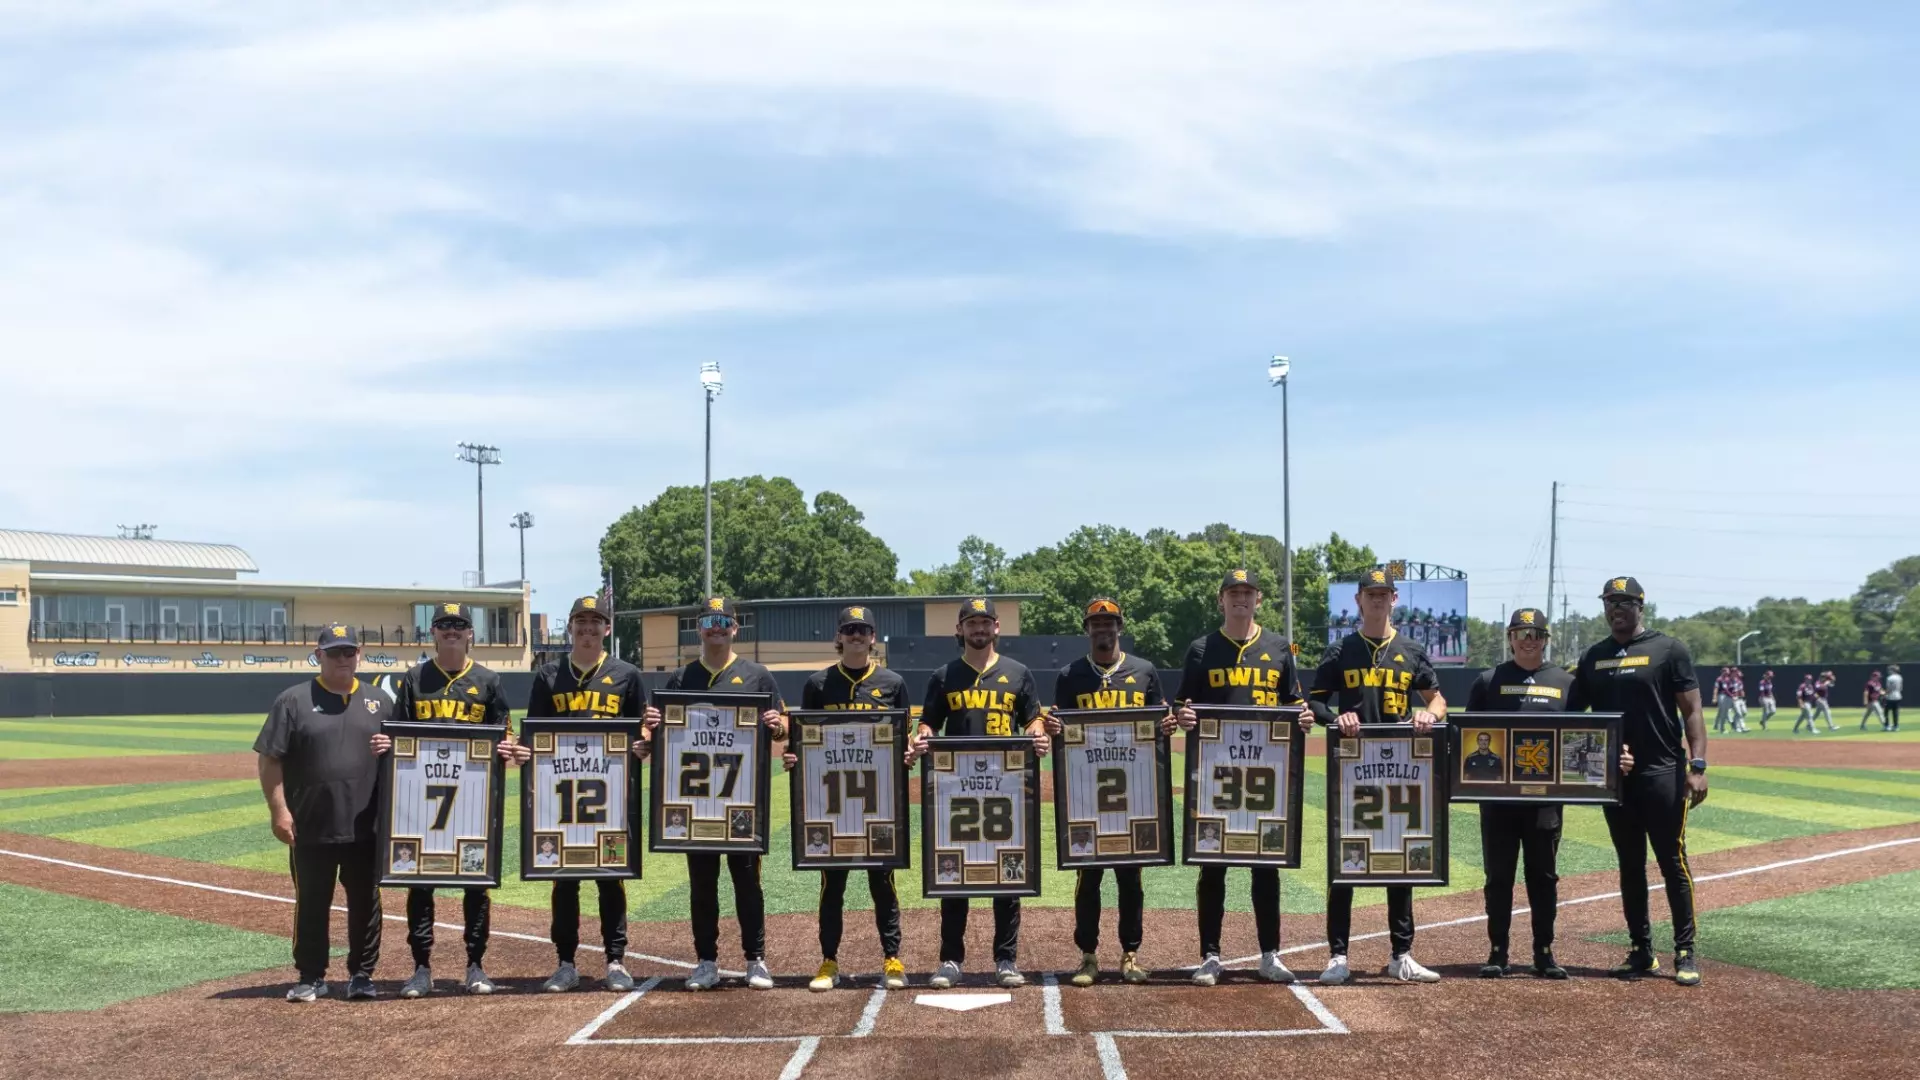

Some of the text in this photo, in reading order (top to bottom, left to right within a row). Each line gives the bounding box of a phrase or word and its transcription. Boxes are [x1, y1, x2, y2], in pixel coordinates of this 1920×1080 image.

[1208, 667, 1280, 688] OWLS
[1344, 668, 1412, 690] OWLS
[415, 699, 486, 722] OWLS
[552, 691, 620, 714] OWLS
[947, 690, 1016, 711] OWLS
[1077, 690, 1145, 709] OWLS
[1383, 691, 1408, 717] 24
[986, 712, 1012, 736] 28
[692, 731, 735, 747] JONES
[825, 749, 873, 764] SLIVER
[1085, 747, 1137, 763] BROOKS
[1229, 745, 1263, 760] CAIN
[425, 763, 461, 779] COLE
[552, 757, 611, 774] HELMAN
[679, 752, 744, 798] 27
[1354, 763, 1420, 780] CHIRELLO
[822, 770, 878, 814] 14
[960, 776, 1003, 791] POSEY
[1097, 768, 1128, 812] 2
[1213, 765, 1275, 812] 39
[425, 785, 459, 831] 7
[555, 779, 607, 824] 12
[1353, 784, 1422, 830] 24
[950, 797, 1013, 842] 28
